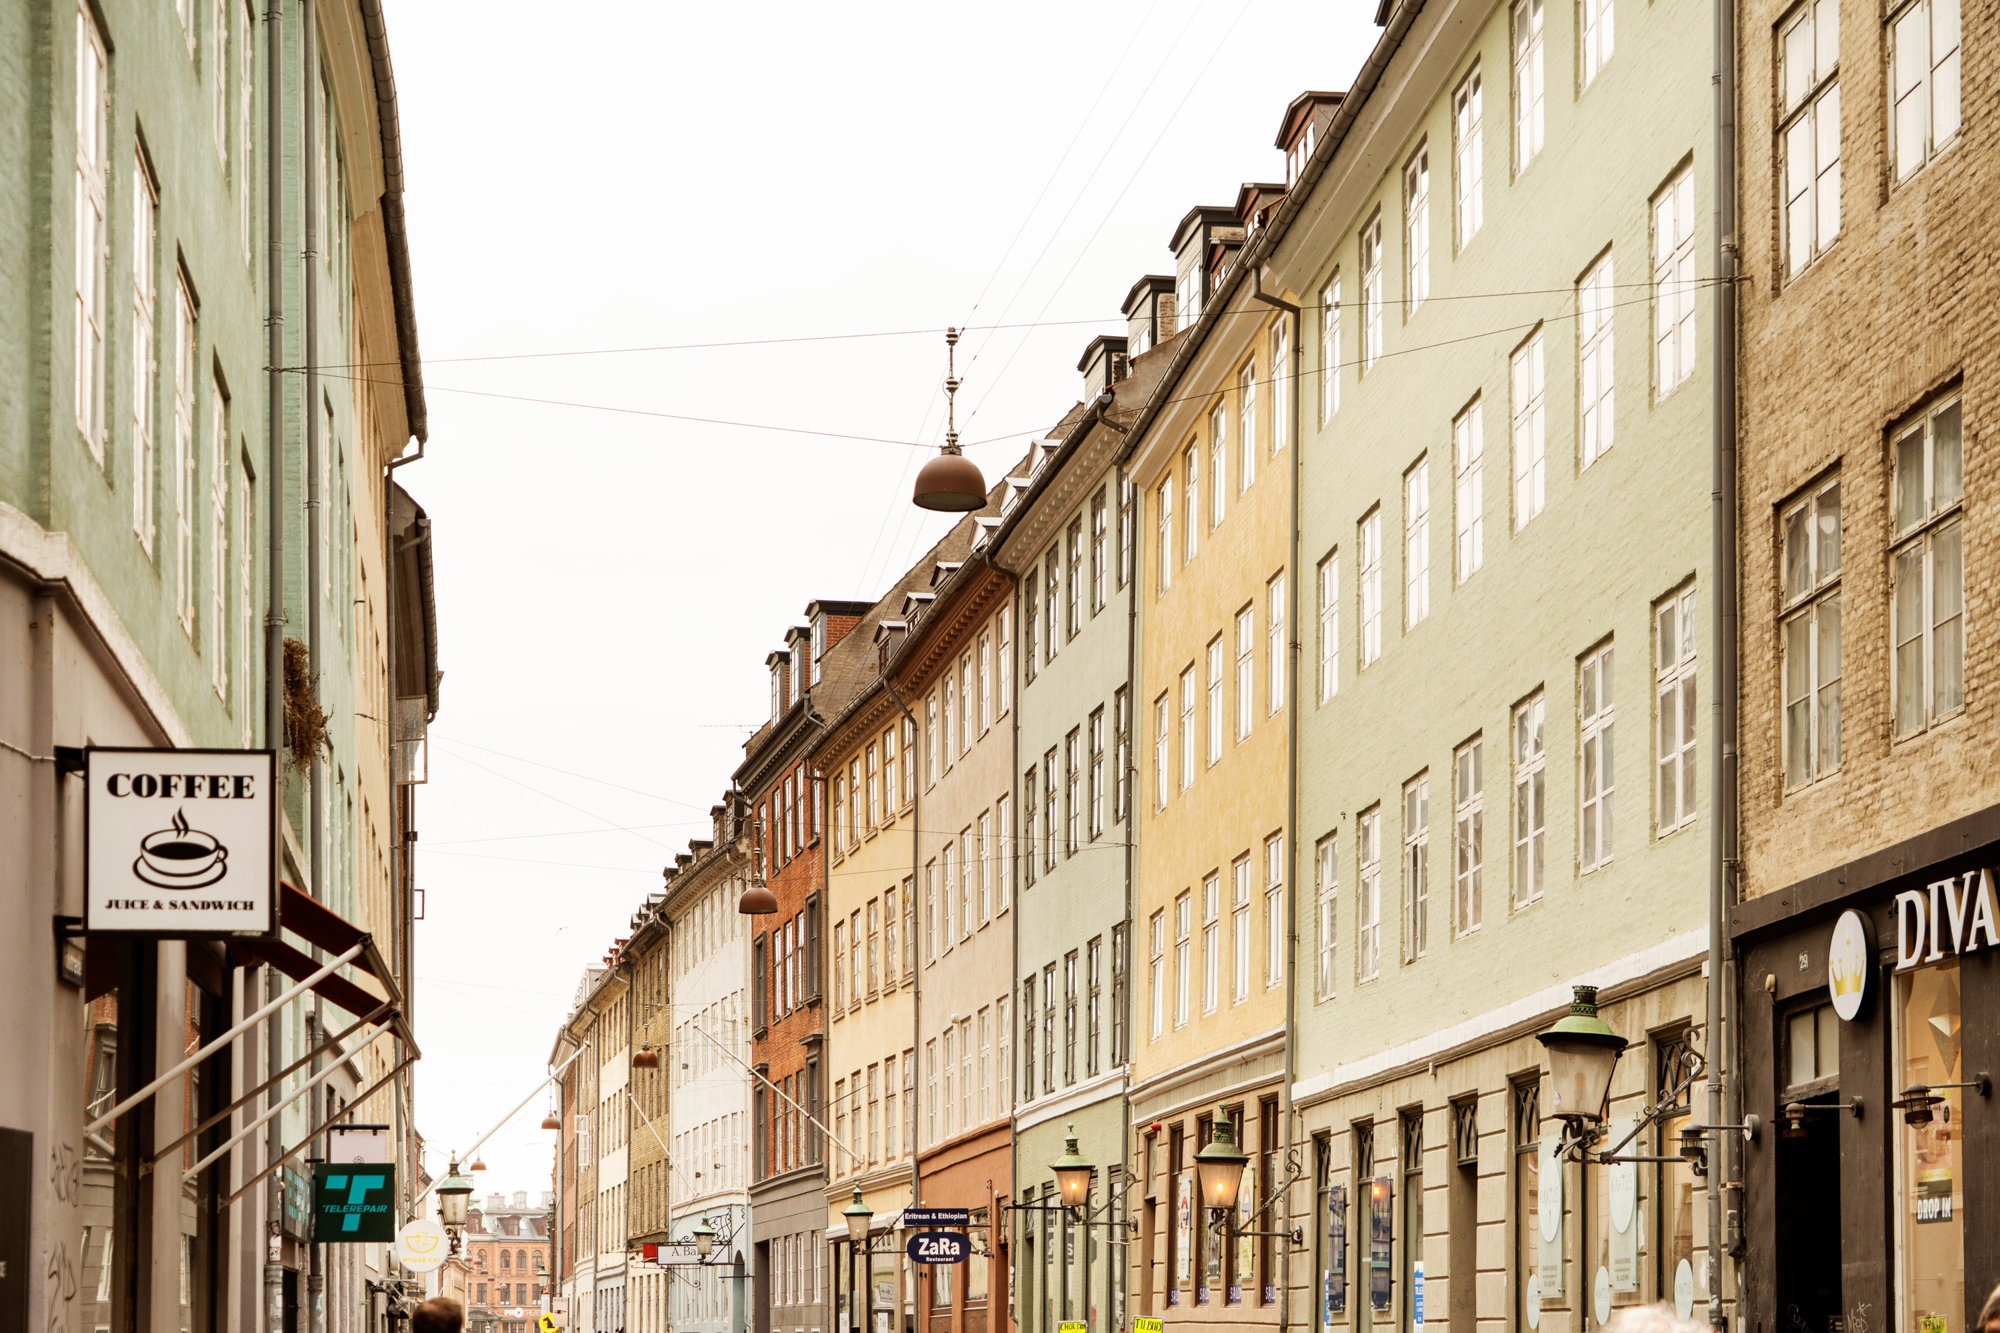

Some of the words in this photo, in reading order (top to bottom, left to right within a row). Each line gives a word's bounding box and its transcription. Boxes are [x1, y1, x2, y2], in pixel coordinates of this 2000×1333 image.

[106, 773, 255, 799] COFFEE
[105, 899, 149, 910] JUICE
[153, 900, 163, 910] &
[168, 900, 254, 911] SANDWICH
[1895, 867, 2000, 971] DIVA
[1800, 955, 1808, 969] 29
[323, 1204, 388, 1214] TELEREPAIR
[1917, 1198, 1940, 1220] DROP
[1941, 1196, 1952, 1218] IN
[904, 1212, 930, 1220] Eritrean
[931, 1212, 937, 1220] &
[938, 1212, 968, 1221] Ethiopian
[918, 1237, 961, 1256] ZaRa
